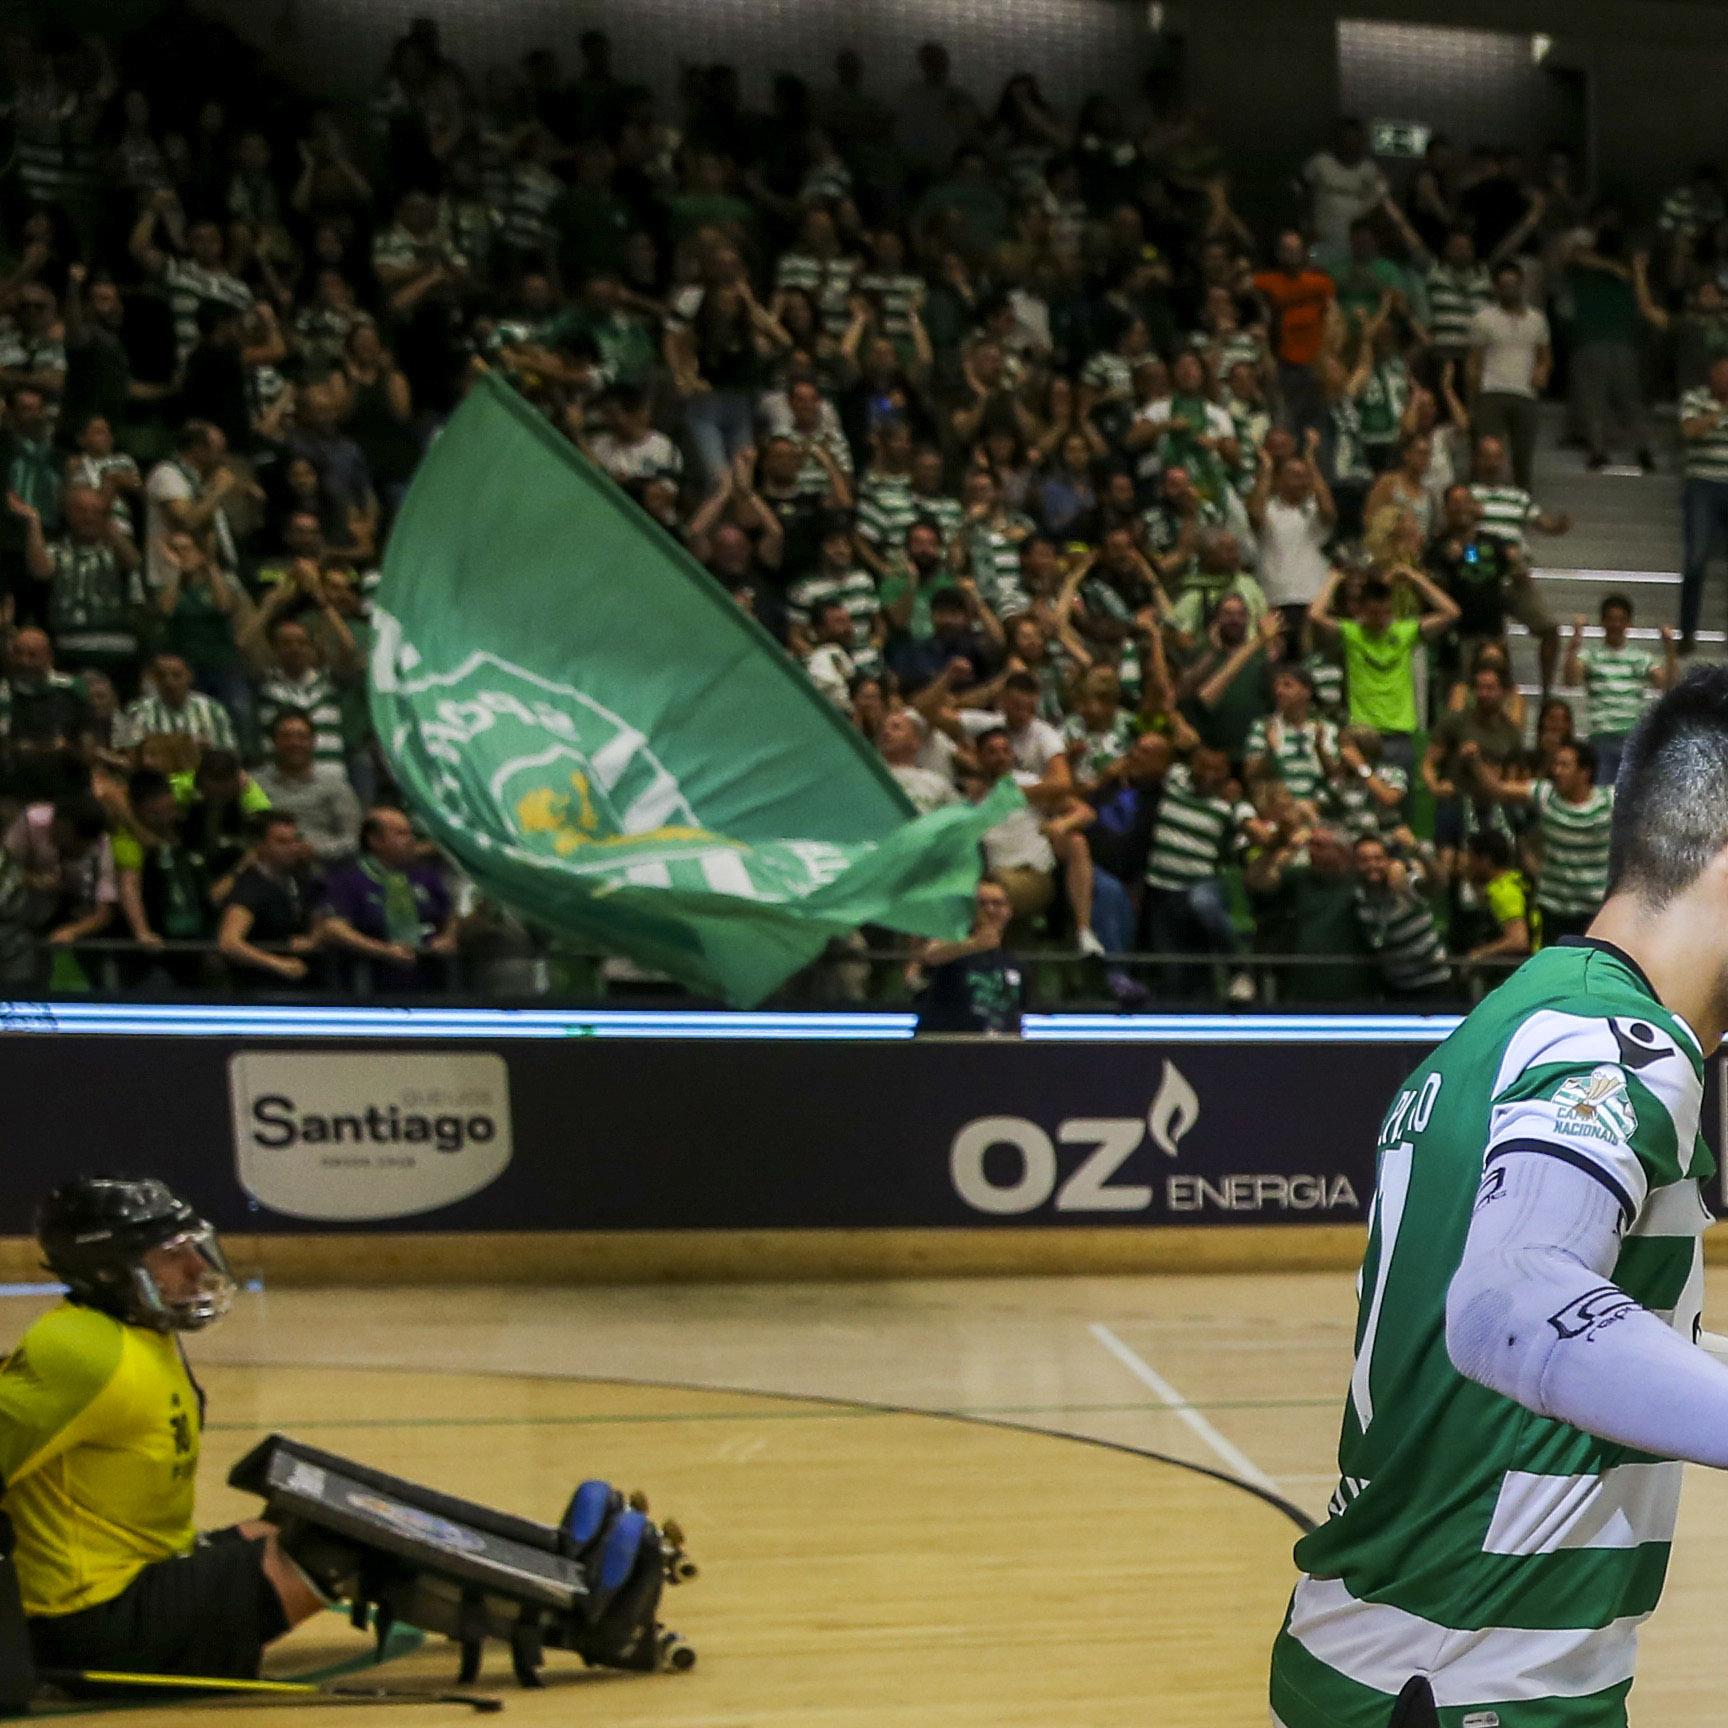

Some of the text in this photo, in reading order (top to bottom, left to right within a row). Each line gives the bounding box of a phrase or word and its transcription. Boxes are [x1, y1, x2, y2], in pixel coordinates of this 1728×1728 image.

[253, 1093, 494, 1153] Santiago
[949, 1114, 1153, 1216] OZ
[1166, 1174, 1360, 1211] ENERGIA
